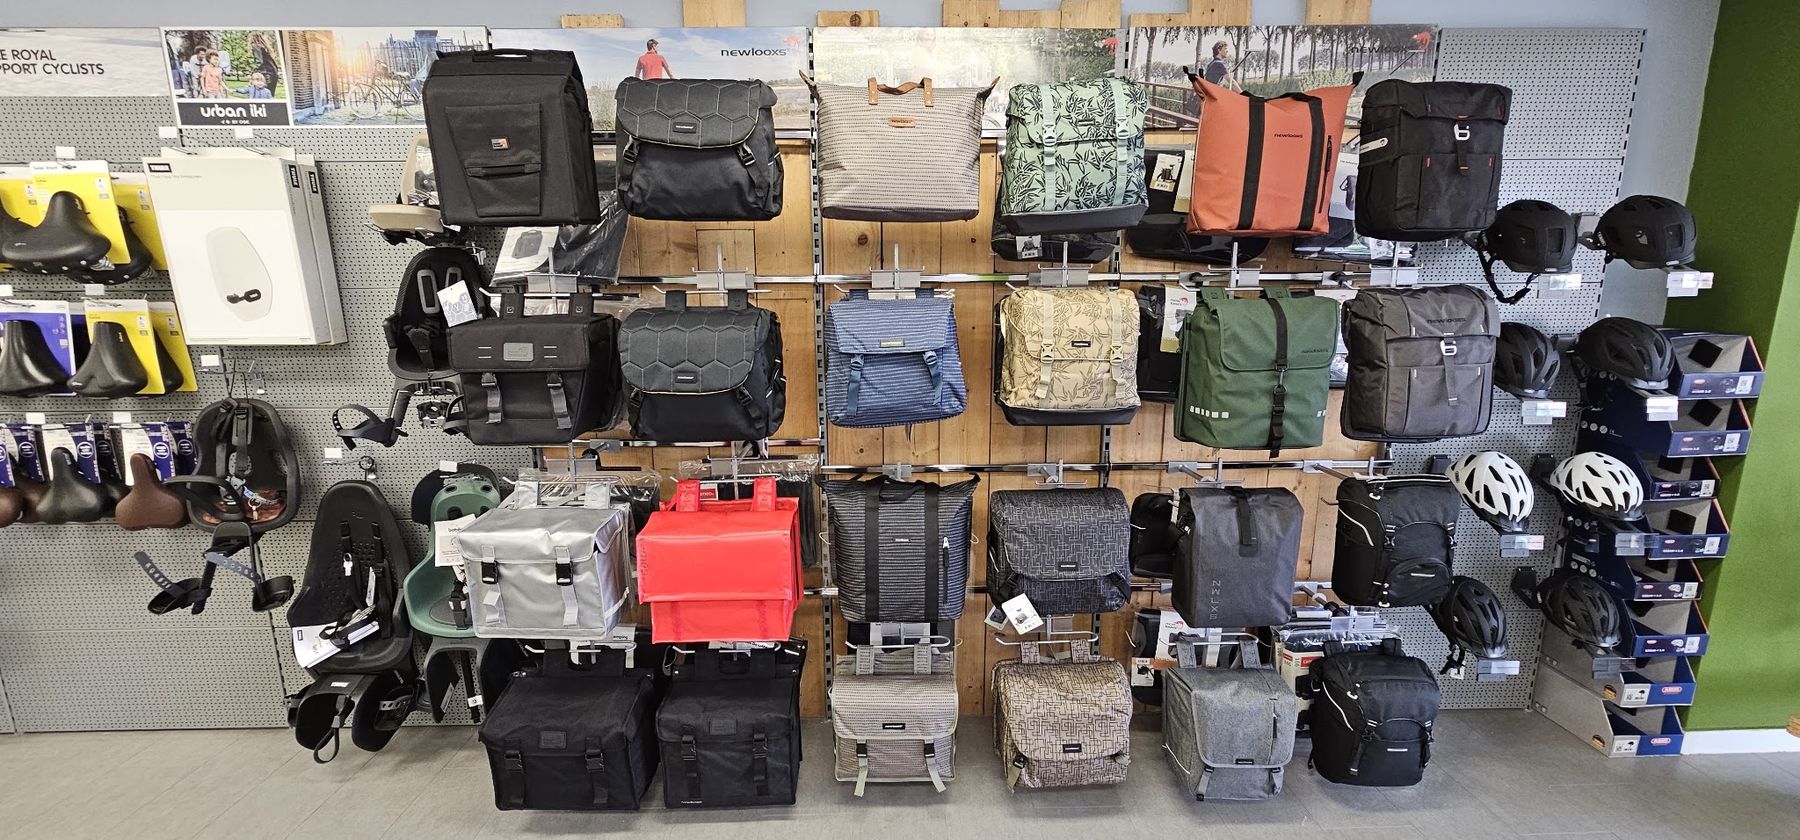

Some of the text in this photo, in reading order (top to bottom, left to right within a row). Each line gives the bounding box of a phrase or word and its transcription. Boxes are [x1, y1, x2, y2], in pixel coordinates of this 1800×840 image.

[0, 49, 57, 61] E ROYAL
[720, 47, 787, 57] newlooxs
[0, 63, 105, 75] PORT CYCLISTS
[200, 103, 268, 118] urban iki
